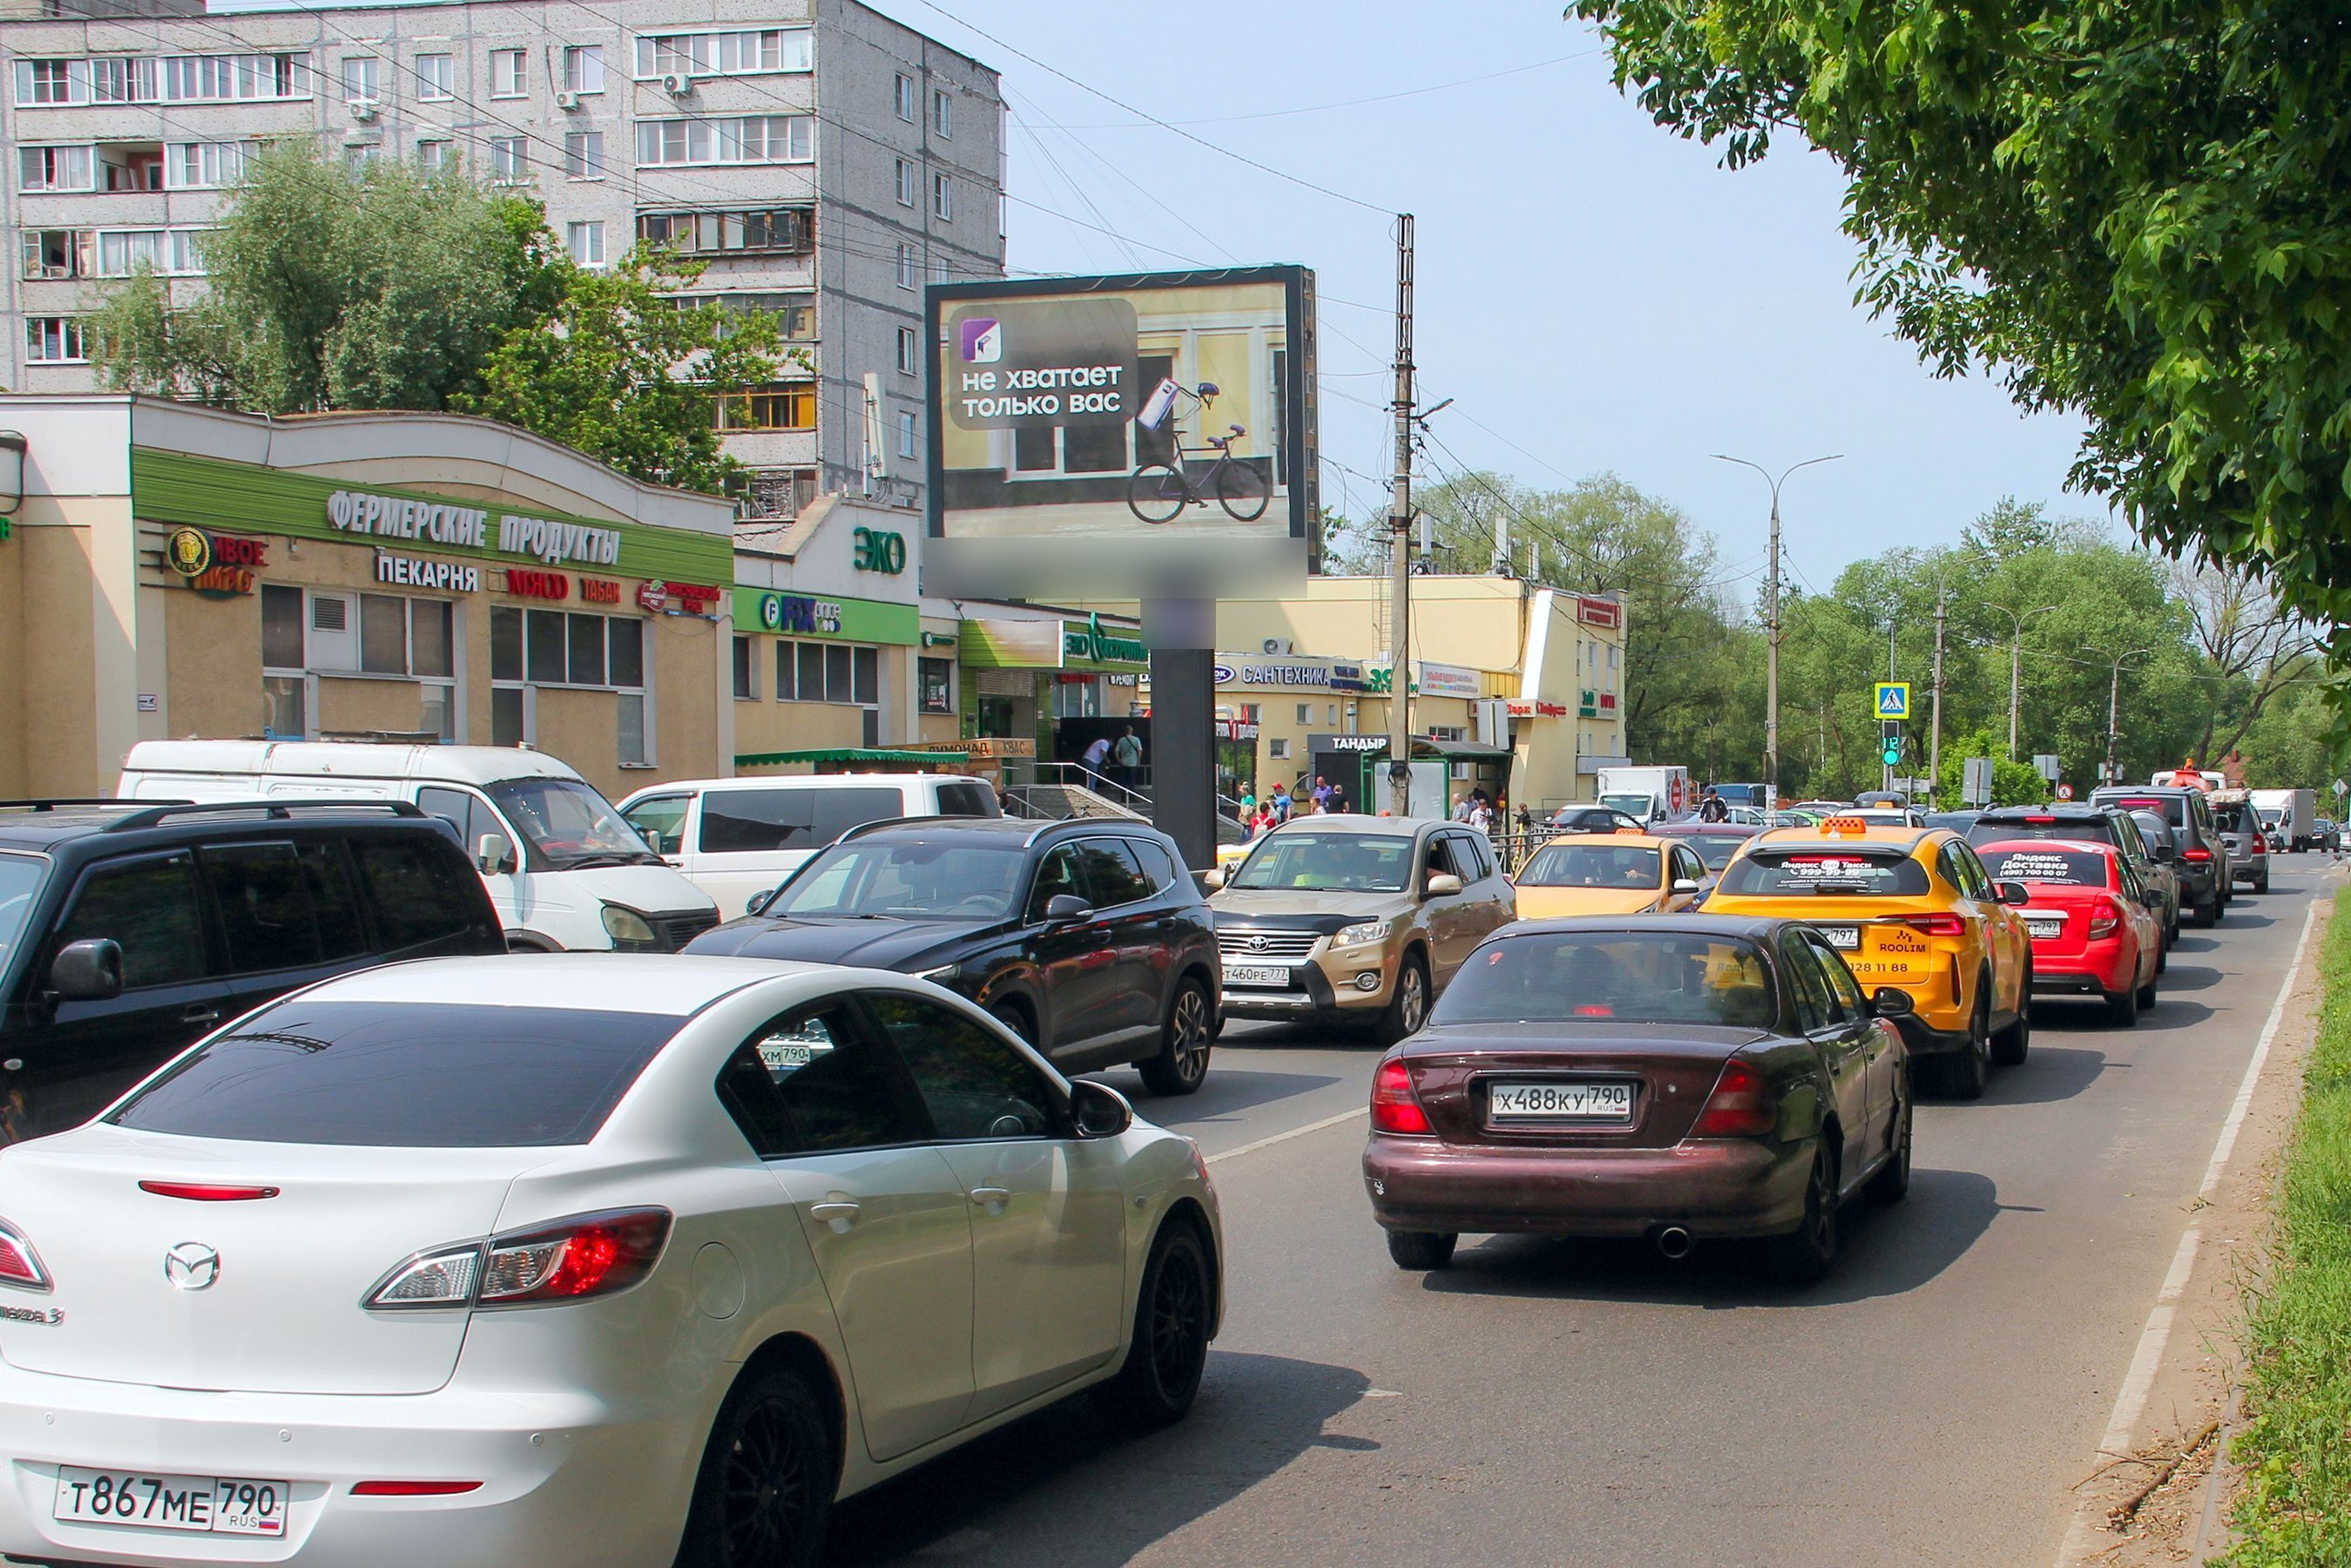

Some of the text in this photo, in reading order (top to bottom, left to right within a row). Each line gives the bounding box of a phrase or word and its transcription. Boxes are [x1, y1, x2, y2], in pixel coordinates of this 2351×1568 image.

[962, 365, 1124, 392] не хватает
[962, 391, 1121, 419] только вас
[327, 490, 620, 565] ФЕРМЕРСКИЕ ПРОДУКТЫ
[854, 526, 907, 575] ЭКО
[376, 555, 480, 592] ПЕКАРНЯ
[507, 568, 570, 600] МЯСО
[579, 578, 621, 604] ТАБАК
[1241, 665, 1331, 686] САНТЕХНИКА
[929, 742, 989, 755] ЛИМОНАД
[1003, 740, 1025, 754] КВАС
[1333, 737, 1388, 751] ТАНДЫР
[2011, 853, 2063, 862] Яндекс
[2000, 860, 2069, 870] Доставка
[2041, 922, 2057, 930] 797
[1833, 929, 1854, 941] 797
[1880, 943, 1926, 952] ROOLIM
[1876, 963, 1886, 972] 11
[1891, 963, 1908, 972] 88
[783, 1048, 806, 1058] 790
[1500, 1086, 1624, 1111] Х488КУ 790
[71, 1475, 277, 1524] Т867МЕ 790
[229, 1515, 258, 1528] RUS
